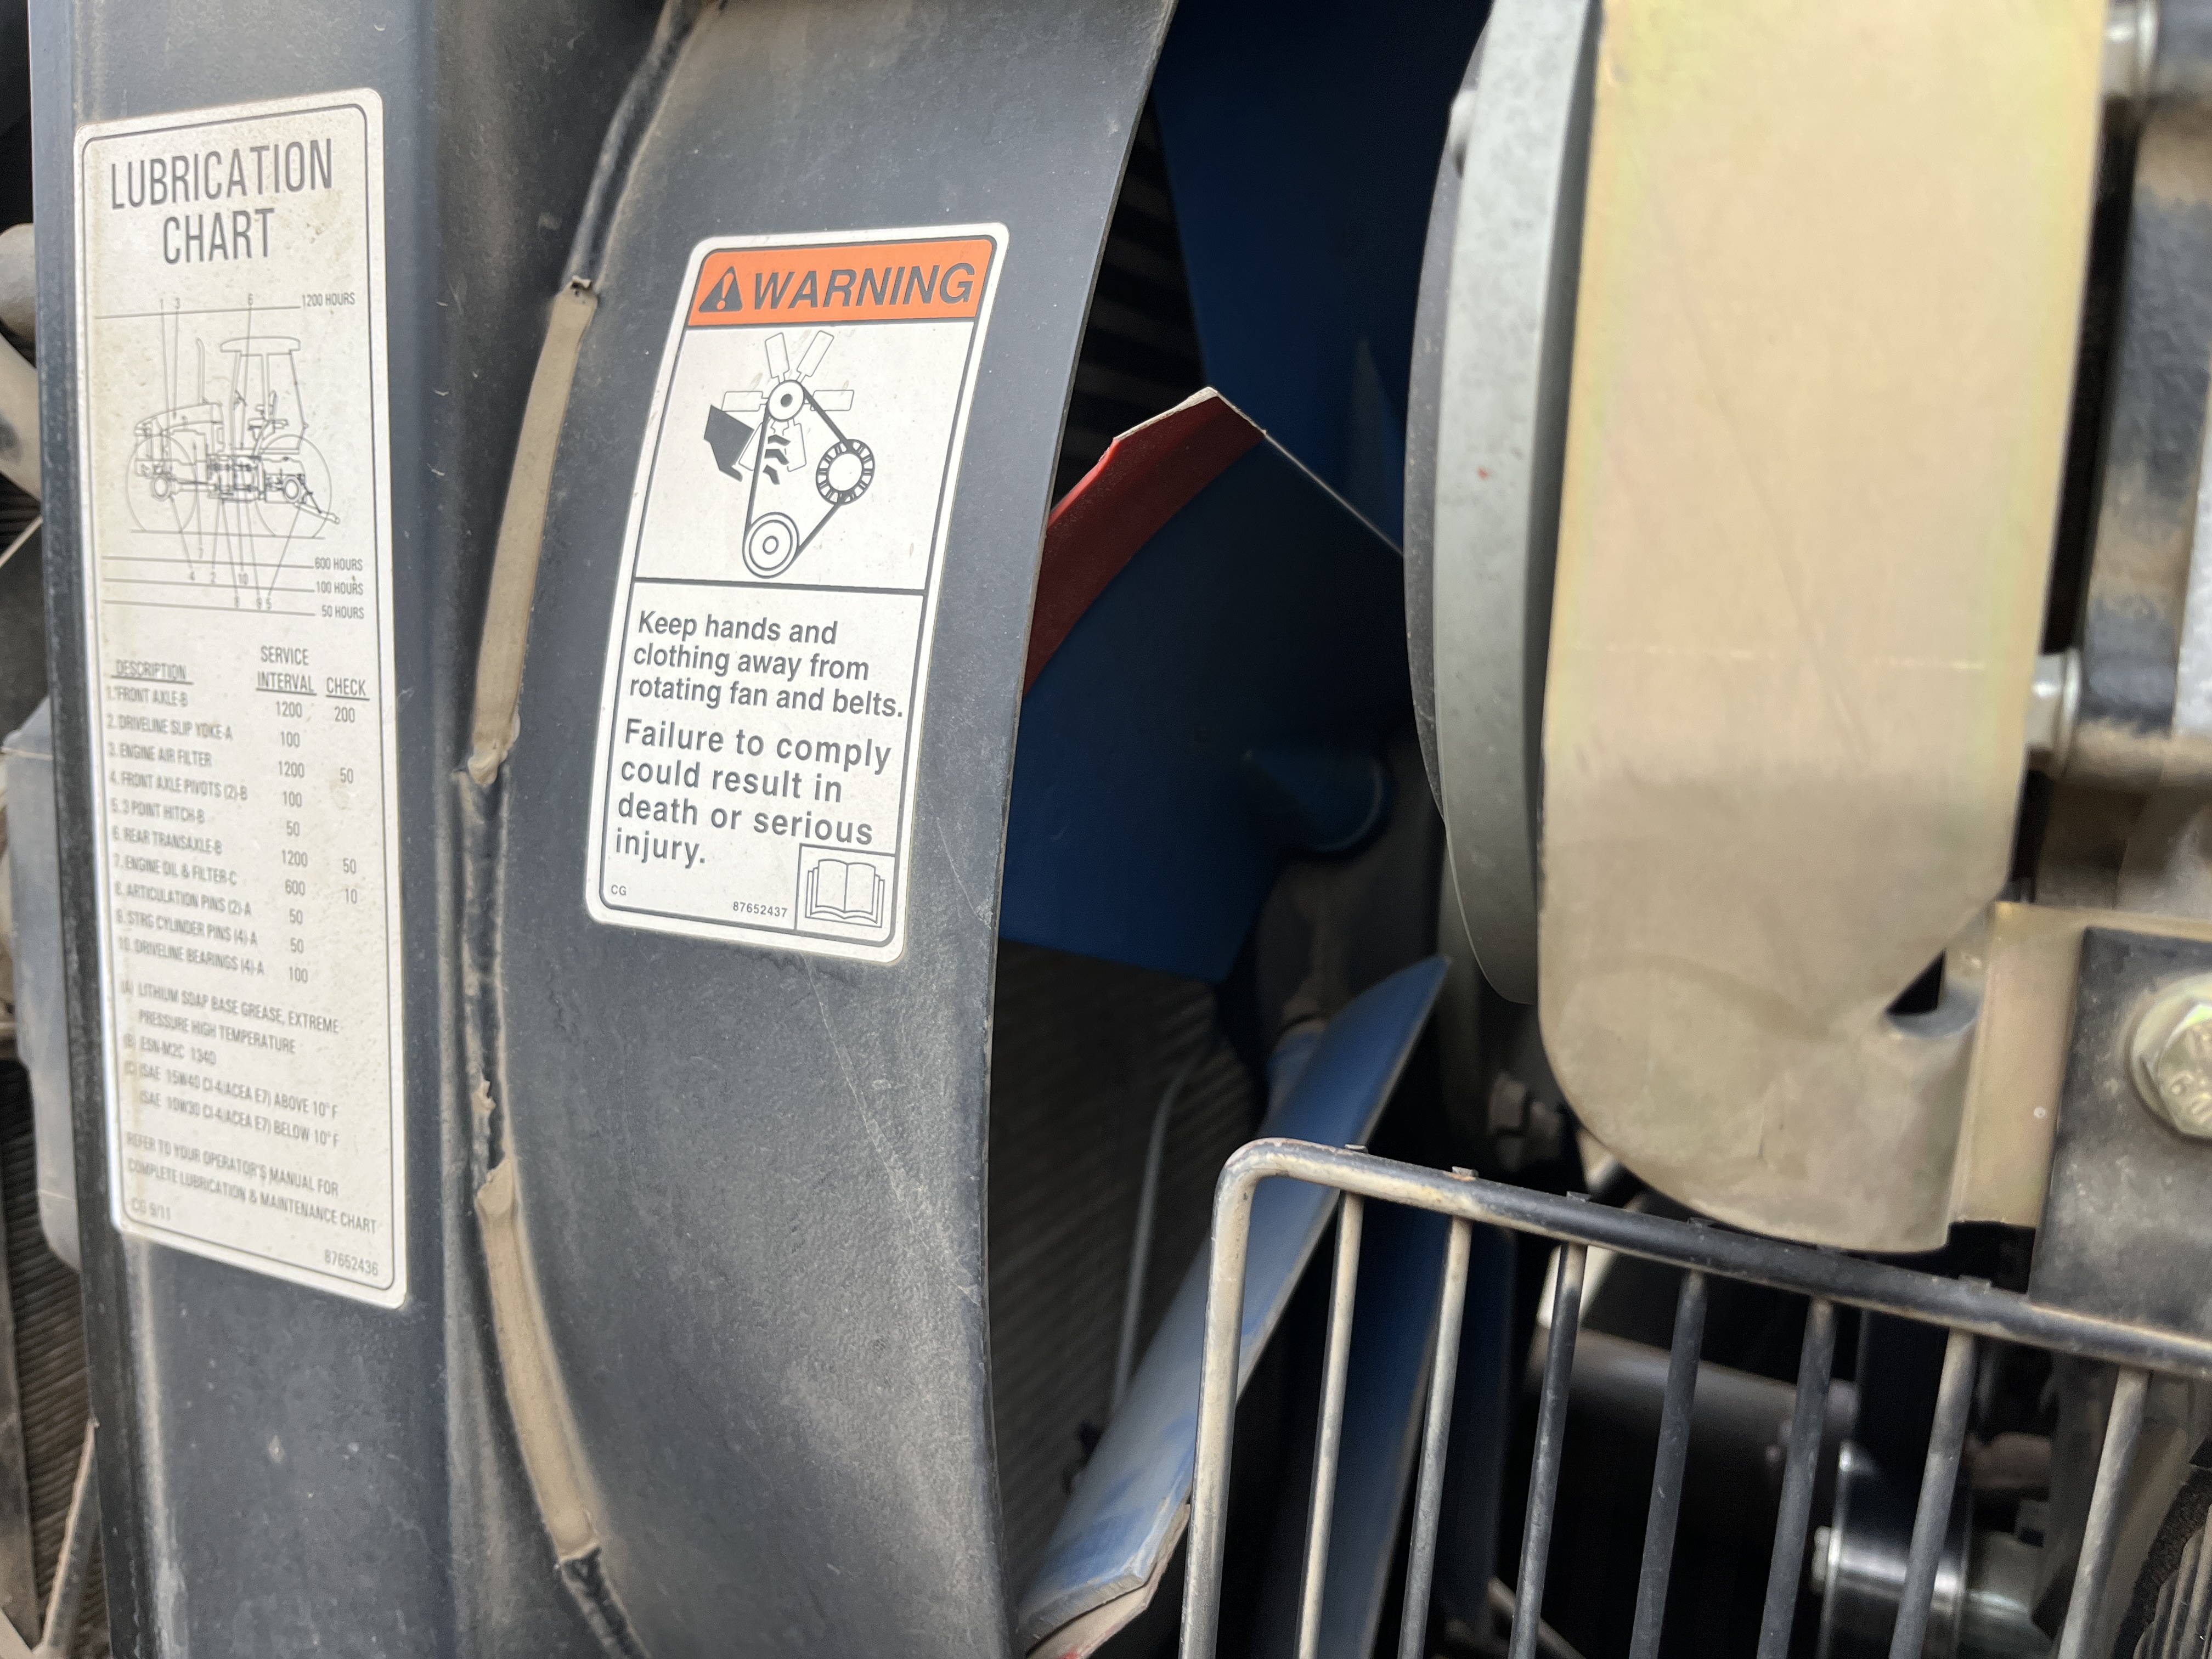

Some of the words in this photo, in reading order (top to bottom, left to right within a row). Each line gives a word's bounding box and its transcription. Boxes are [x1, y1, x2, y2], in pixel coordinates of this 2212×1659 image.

[111, 138, 332, 210] LUBRICATION
[163, 208, 275, 264] CHART
[755, 262, 975, 311] WARNING
[302, 293, 323, 307] 1200
[325, 291, 356, 306] HOURS
[315, 556, 331, 570] 600
[334, 557, 363, 571] HOURS
[317, 580, 332, 594] 100
[334, 581, 364, 595] HOURS
[321, 604, 332, 618] 50
[335, 605, 364, 619] HOURS
[638, 611, 697, 641] Keep
[705, 614, 781, 641] hands
[789, 620, 838, 645] and
[261, 645, 309, 665] SERVICE
[633, 643, 730, 677] clothing
[737, 654, 802, 682] away
[810, 653, 870, 681] from
[116, 659, 187, 680] DESCRIPTION
[257, 670, 314, 692] INTERVAL
[326, 676, 366, 696] CHECK
[115, 686, 150, 703] FRONT
[630, 676, 721, 709] rotating
[730, 681, 768, 707] fan
[776, 687, 825, 712] and
[833, 689, 903, 718] belts.
[276, 701, 302, 718] 1200
[334, 706, 356, 723] 200
[118, 714, 168, 734] DRIVELINE
[170, 719, 193, 736] SLIP
[280, 731, 301, 747] 100
[625, 718, 724, 752] Failure
[736, 729, 764, 757] to
[776, 737, 892, 775] comply
[120, 743, 155, 761] ENGINE
[158, 747, 176, 763] AIR
[177, 748, 212, 767] FILTER
[278, 760, 305, 778] 1200
[340, 767, 354, 784] 50
[121, 771, 153, 789] FRONT
[155, 775, 182, 793] AXLE
[184, 777, 222, 798] PIVOTS
[621, 759, 701, 788] could
[713, 769, 802, 799] result
[814, 772, 842, 803] in
[122, 798, 129, 815] 3
[131, 799, 161, 818] POINT
[283, 791, 302, 808] 100
[286, 820, 301, 837] 50
[618, 792, 698, 826] death
[710, 807, 742, 830] or
[753, 810, 873, 845] serious
[123, 827, 151, 845] REAR
[281, 849, 308, 867] 1200
[616, 827, 706, 869] injury.
[125, 854, 160, 874] ENGINE
[162, 860, 179, 877] OIL
[181, 862, 190, 878] &
[342, 857, 357, 874] 50
[285, 879, 306, 896] 600
[345, 888, 358, 905] 10
[611, 884, 627, 896] CG
[126, 883, 199, 907] ARTICULATION
[201, 894, 226, 913] PINS
[289, 908, 303, 925] 50
[732, 901, 788, 918] 87652437
[127, 910, 154, 929] STRG
[156, 915, 206, 937] CYLINDER
[207, 923, 232, 942] PINS
[133, 938, 184, 961] DRIVELINE
[186, 947, 239, 971] BEARINGS
[290, 937, 304, 954] 50
[289, 966, 309, 984] 100
[138, 981, 179, 1003] LITHIUM
[181, 990, 209, 1008] SOAP
[211, 995, 239, 1015] BASE
[240, 1001, 286, 1026] GREASE,
[288, 1010, 339, 1035] EXTREME
[139, 1008, 190, 1034] PRESSURE
[191, 1020, 217, 1038] HIGH
[219, 1024, 296, 1054] TEMPERATURE
[274, 1092, 309, 1114] ABOVE
[274, 1119, 311, 1142] BELOW
[157, 1138, 172, 1156] TO
[173, 1142, 201, 1163] YOUR
[203, 1150, 267, 1181] OPERATOR'S
[268, 1166, 315, 1191] MANUAL
[317, 1178, 339, 1198] FOR
[127, 1158, 178, 1184] COMPLETE
[179, 1171, 247, 1203] LUBRICATION
[249, 1188, 258, 1205] &
[259, 1191, 338, 1225] MAINTENANCE
[340, 1211, 377, 1235] CHART
